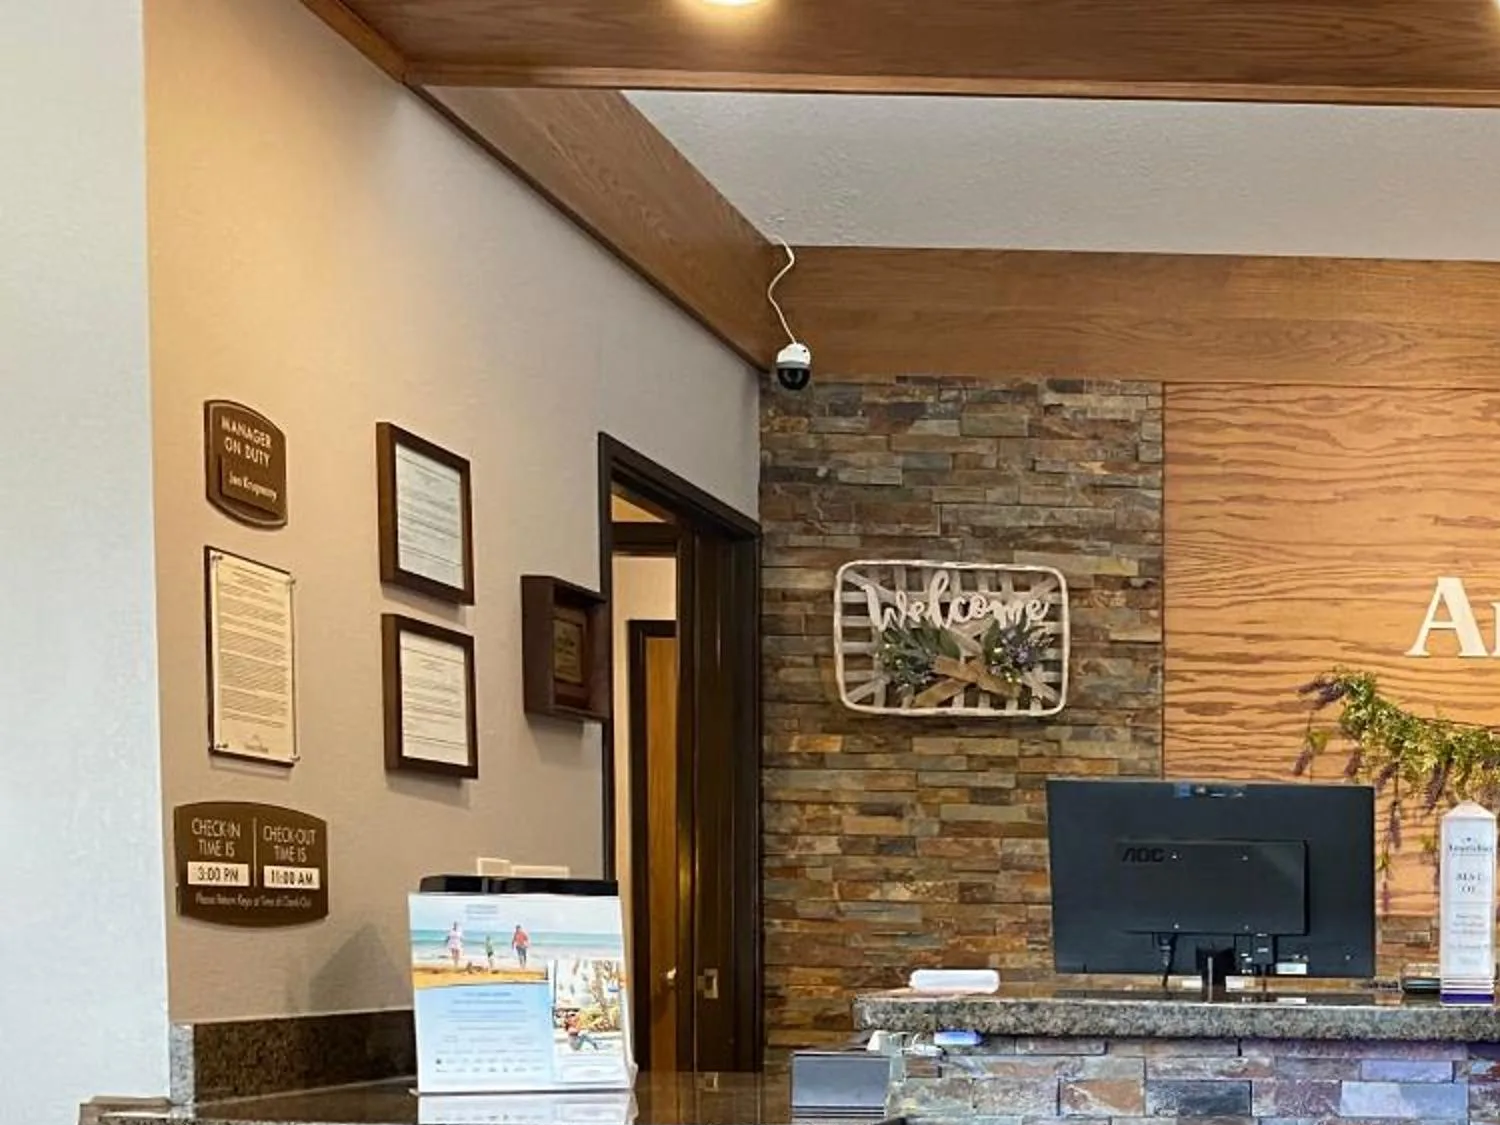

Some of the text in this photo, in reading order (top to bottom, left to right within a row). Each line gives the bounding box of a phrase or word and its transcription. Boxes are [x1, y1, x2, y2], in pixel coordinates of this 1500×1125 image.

[221, 415, 271, 448] MANAGER
[224, 436, 270, 468] ON DUTY
[861, 570, 1049, 632] Welcome
[191, 817, 241, 838] CHECK-IN
[263, 825, 317, 846] CHECK-OUT
[198, 838, 235, 858] TIME IS
[273, 845, 307, 863] TIME IS
[1121, 847, 1165, 862] AOC
[197, 865, 239, 882] 3:00 PM
[271, 869, 313, 885] 11:00 AM
